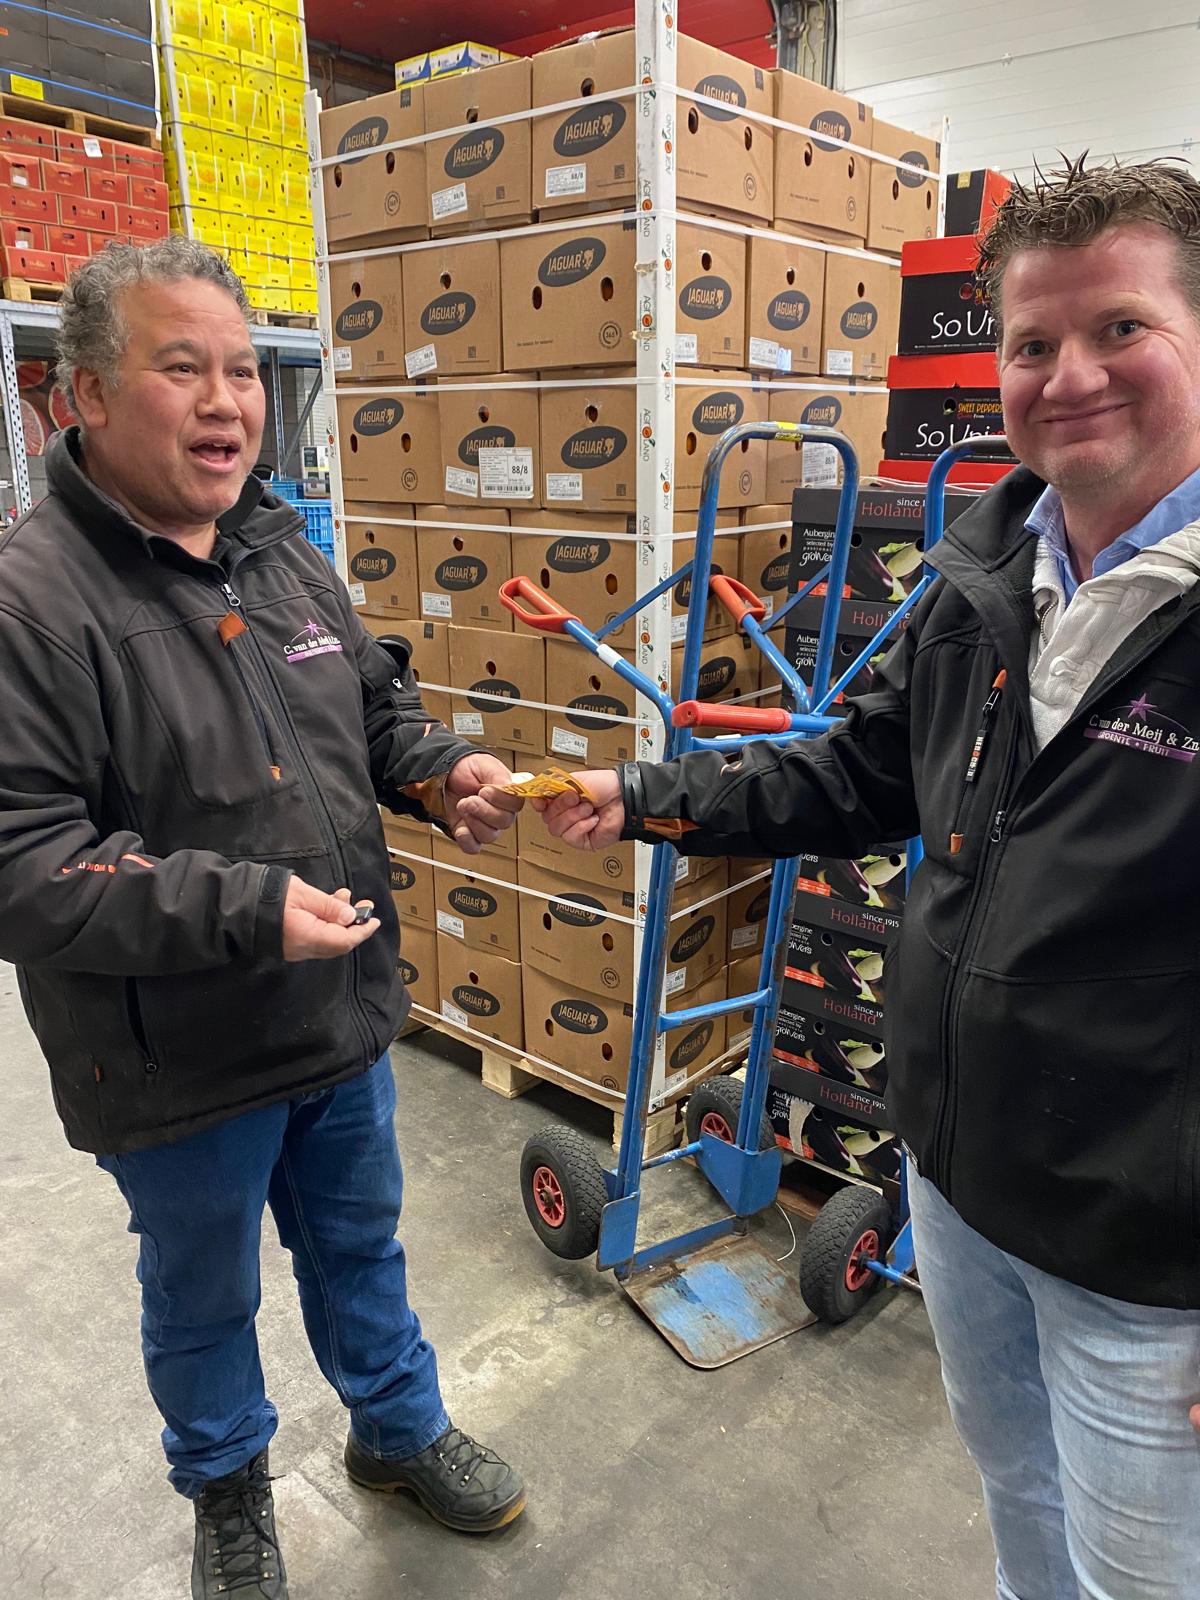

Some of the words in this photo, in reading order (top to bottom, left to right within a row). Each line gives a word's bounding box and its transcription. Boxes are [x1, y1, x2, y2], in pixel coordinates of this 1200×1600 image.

[704, 84, 730, 103] JAGUAR
[563, 119, 600, 145] JAGUAR
[345, 133, 370, 152] JAGUAR
[453, 144, 482, 168] JAGUAR
[547, 255, 582, 275] JAGUAR
[688, 288, 715, 305] JAGUAR
[429, 306, 456, 325] JAGUAR
[774, 301, 798, 317] JAGUAR
[342, 314, 366, 331] JAGUAR
[846, 312, 867, 328] JAGUAR
[931, 312, 962, 339] So
[701, 405, 728, 423] JAGUAR
[808, 407, 829, 423] JAGUAR
[958, 403, 975, 413] SWEET
[360, 410, 386, 425] JAGUAR
[916, 423, 944, 447] So
[570, 440, 603, 456] JAGUAR
[512, 465, 528, 475] 88/8
[861, 502, 923, 518] Holland
[897, 498, 920, 507] since
[803, 529, 836, 539] Aubergin
[555, 544, 587, 561] JAGUAR
[357, 557, 380, 571] JAGUAR
[442, 565, 469, 579] JAGUAR
[768, 564, 789, 582] JAGUAR
[888, 609, 910, 619] sie
[293, 643, 308, 652] van
[699, 669, 721, 688] AGUAR
[1111, 718, 1130, 733] der
[1132, 722, 1163, 745] Meij
[1166, 732, 1178, 746] &
[1142, 743, 1170, 757] FRUIT
[455, 891, 480, 909] JAGUAR
[830, 908, 885, 934] Holland
[862, 912, 883, 923] since
[885, 918, 900, 927] 1915
[678, 934, 702, 953] JAGUAR
[459, 990, 483, 1008] JAGUAR
[559, 1004, 588, 1025] JAGUAR
[779, 1009, 806, 1023] ubergine
[823, 998, 877, 1026] Holland
[853, 1004, 874, 1016] since
[678, 1041, 703, 1063] JAGUAR
[820, 1086, 873, 1115] Holland
[850, 1092, 870, 1104] since
[872, 1100, 886, 1110] 1915
